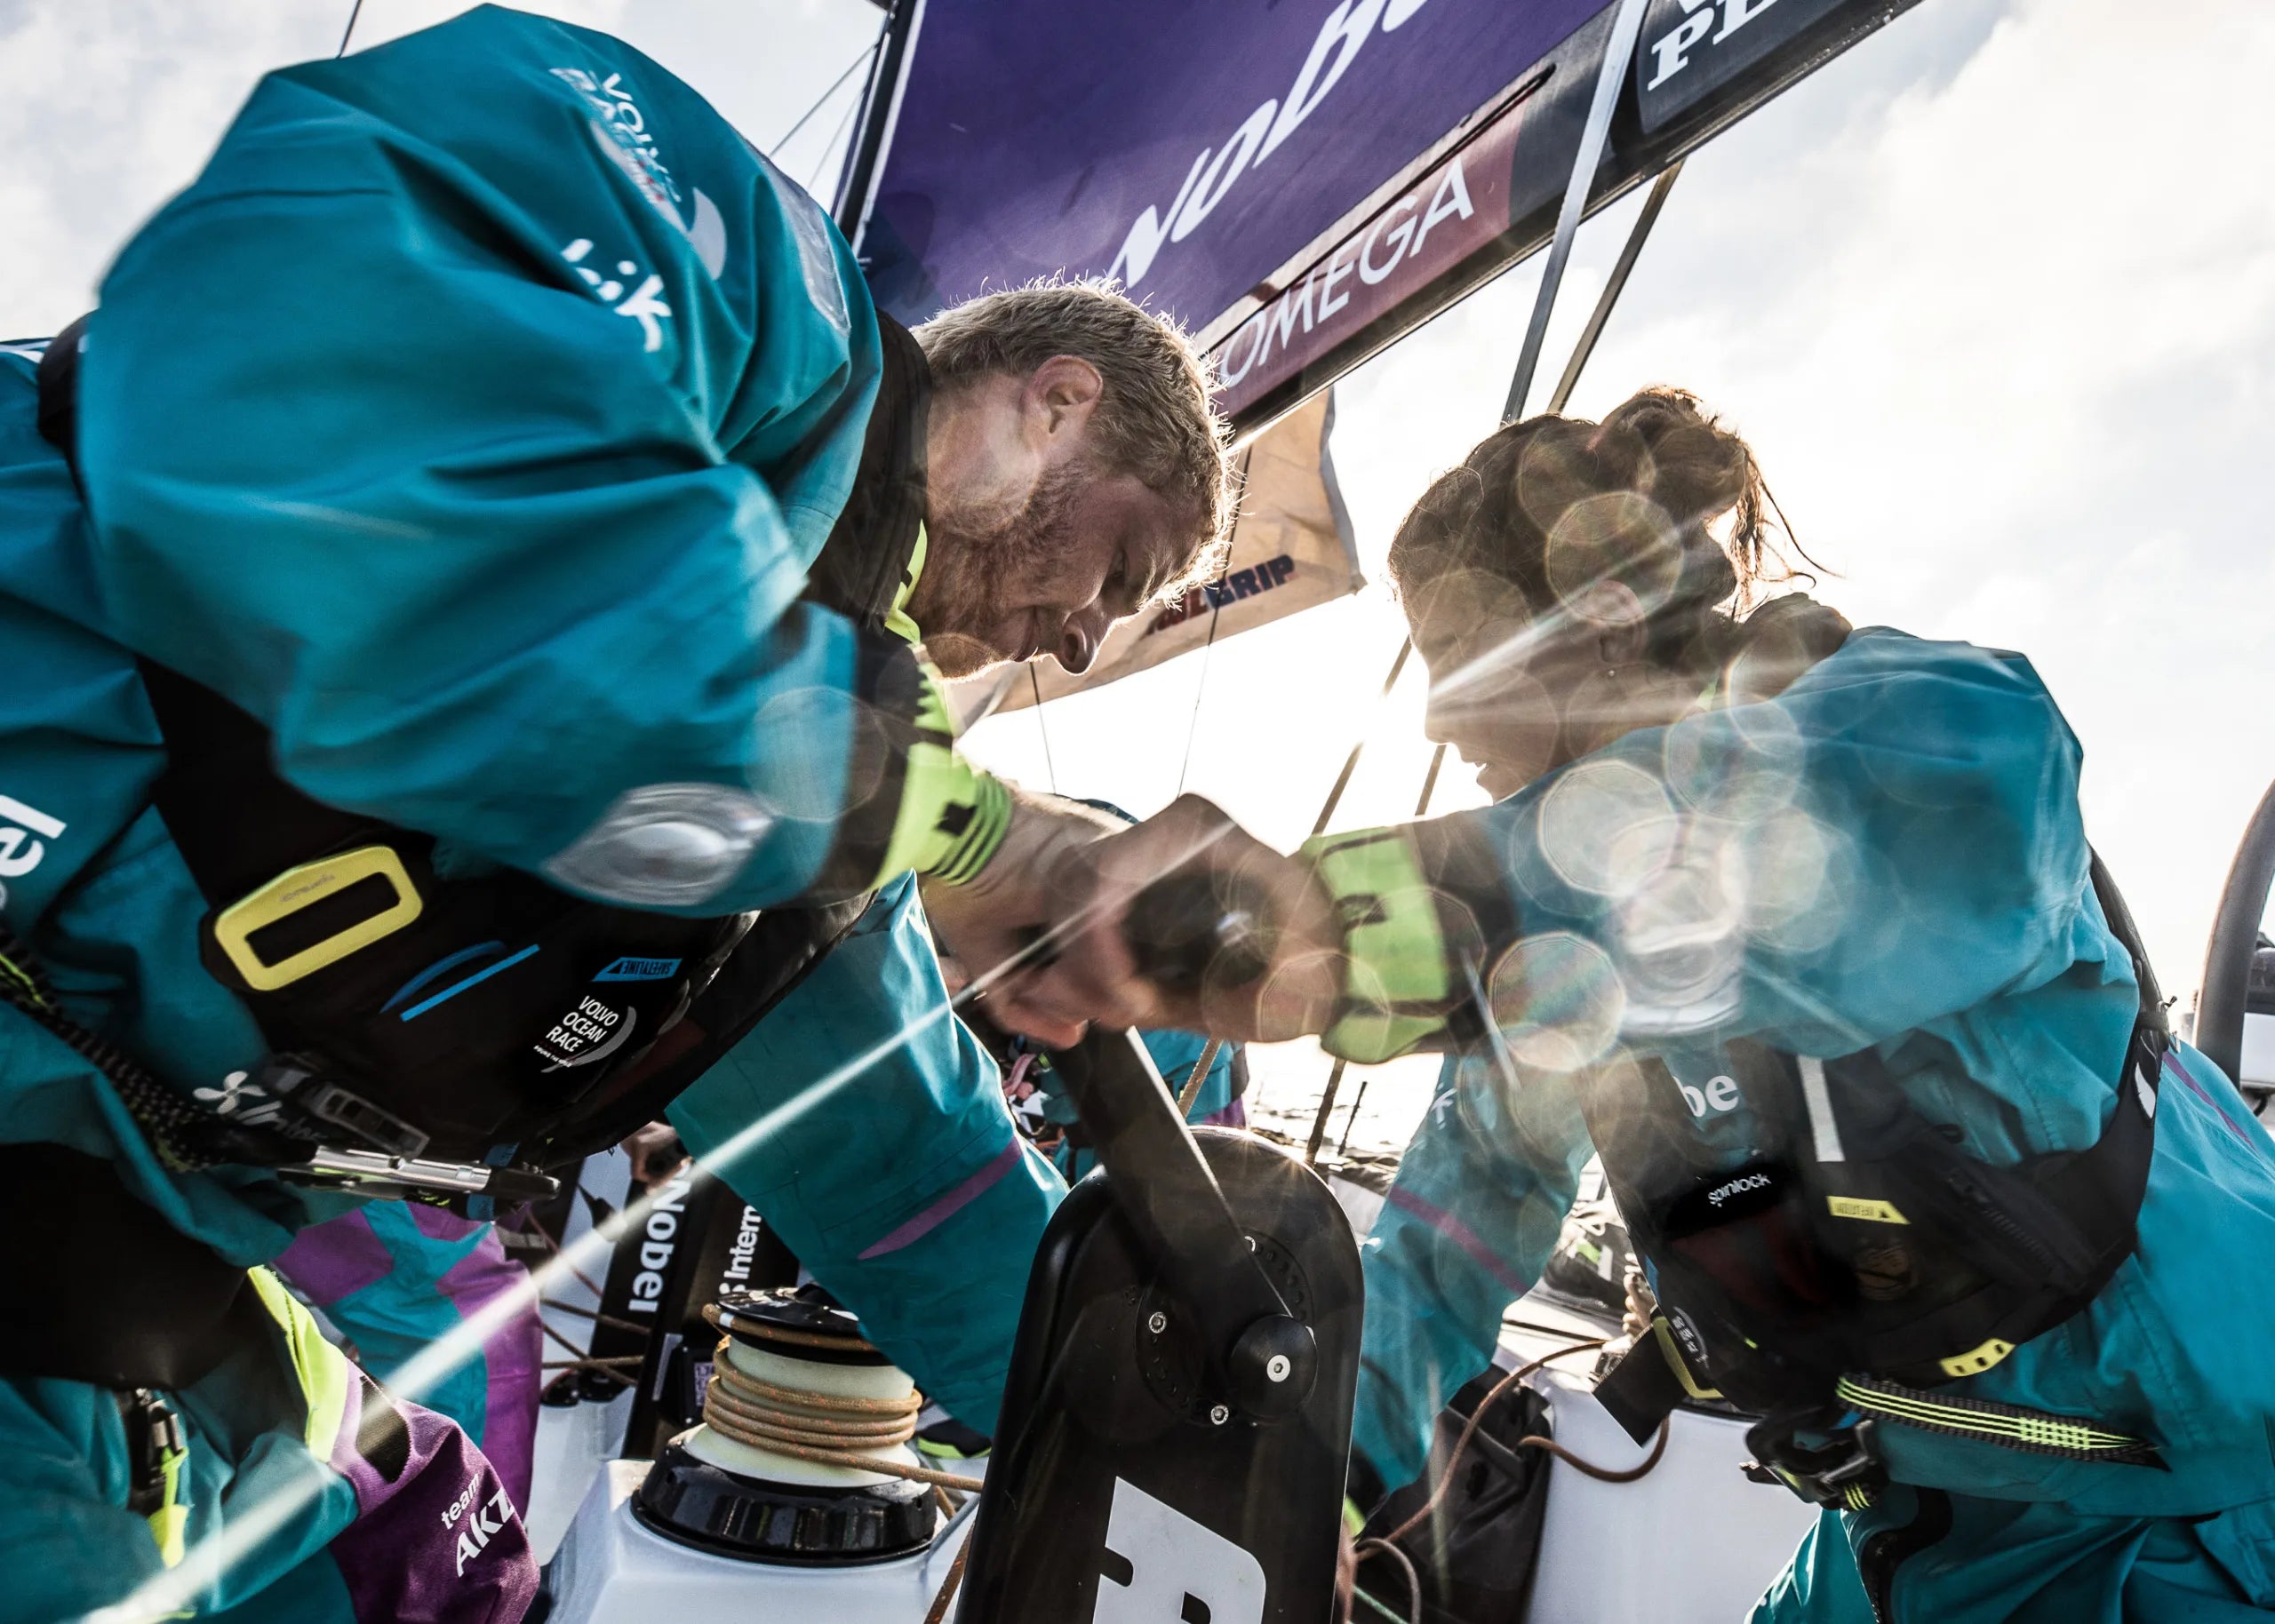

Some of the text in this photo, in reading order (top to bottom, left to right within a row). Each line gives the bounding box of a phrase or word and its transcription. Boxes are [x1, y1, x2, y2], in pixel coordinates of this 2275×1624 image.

[1220, 156, 1474, 387] OMEGA
[579, 995, 620, 1027] VOLVO
[546, 1025, 584, 1053] RACE
[563, 1012, 607, 1043] OCEAN
[441, 1473, 480, 1530] team
